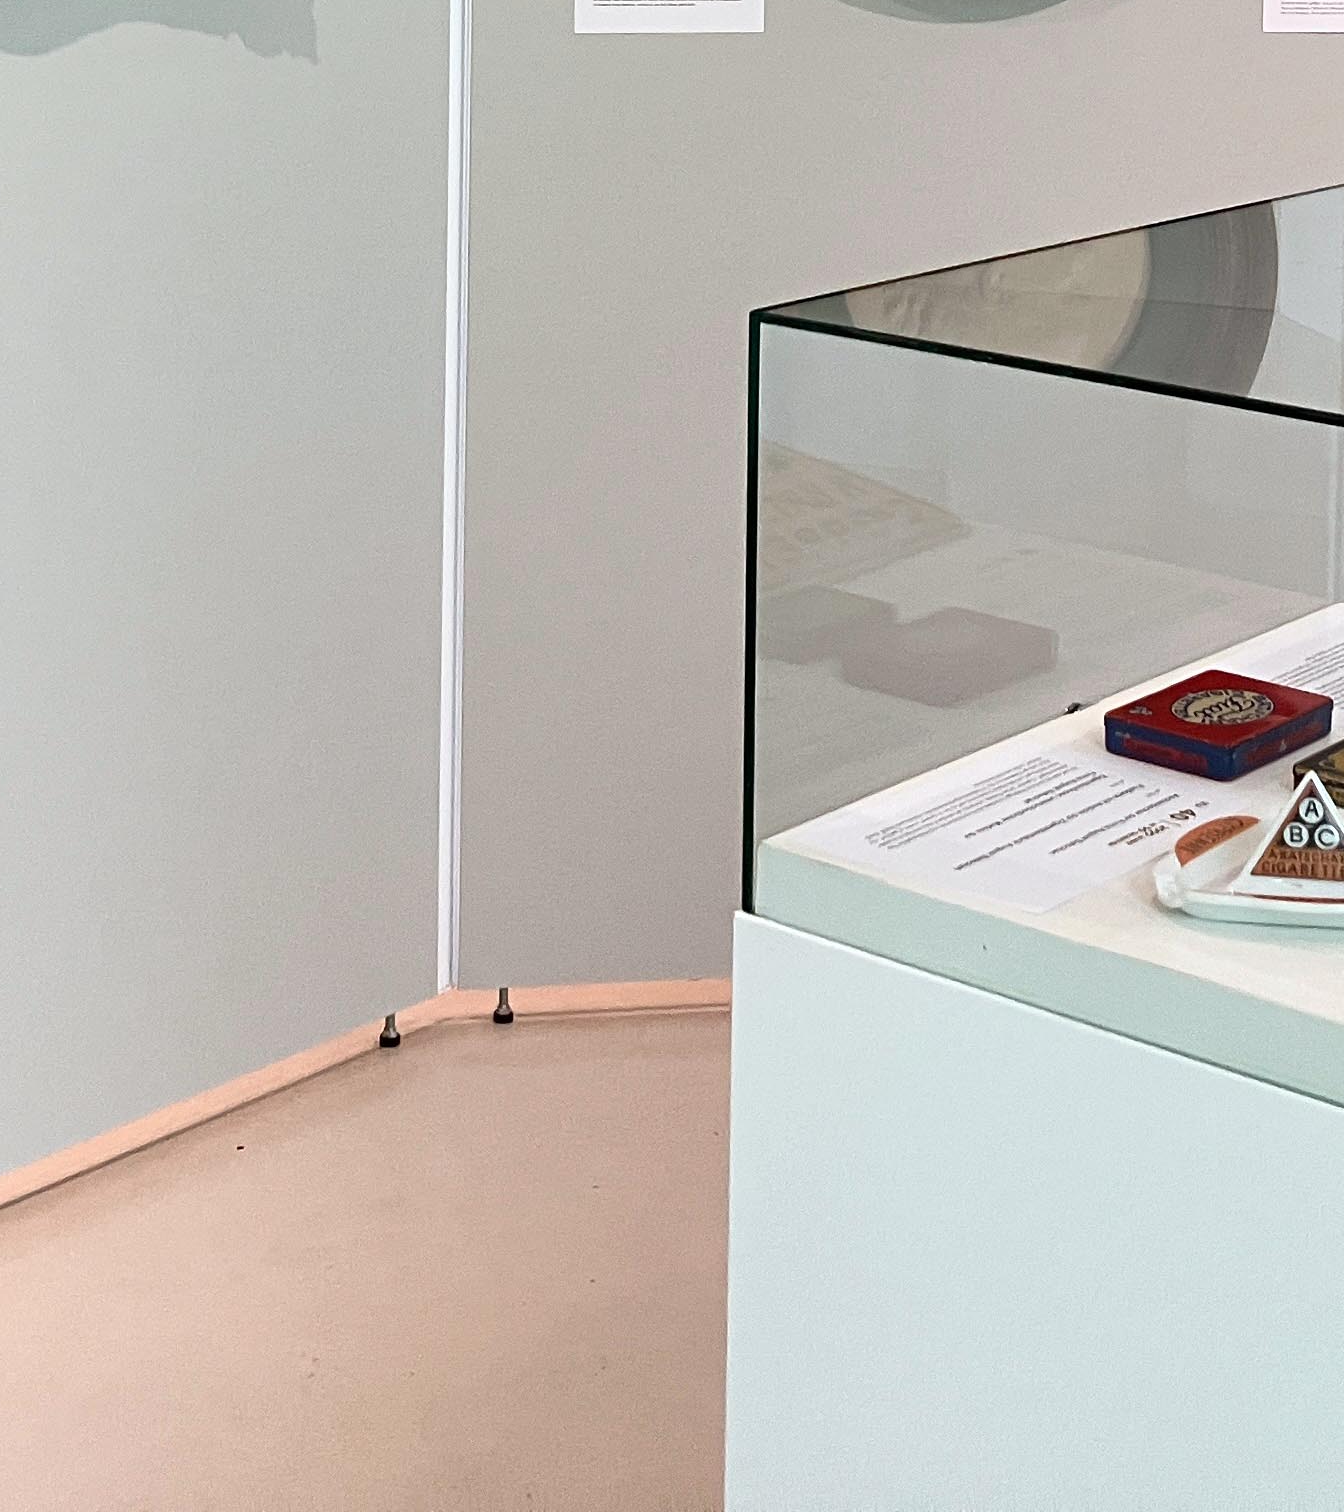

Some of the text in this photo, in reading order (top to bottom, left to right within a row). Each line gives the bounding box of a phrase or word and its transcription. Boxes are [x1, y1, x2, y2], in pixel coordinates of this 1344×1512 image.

[1305, 800, 1319, 818] A
[1289, 825, 1334, 846] B C
